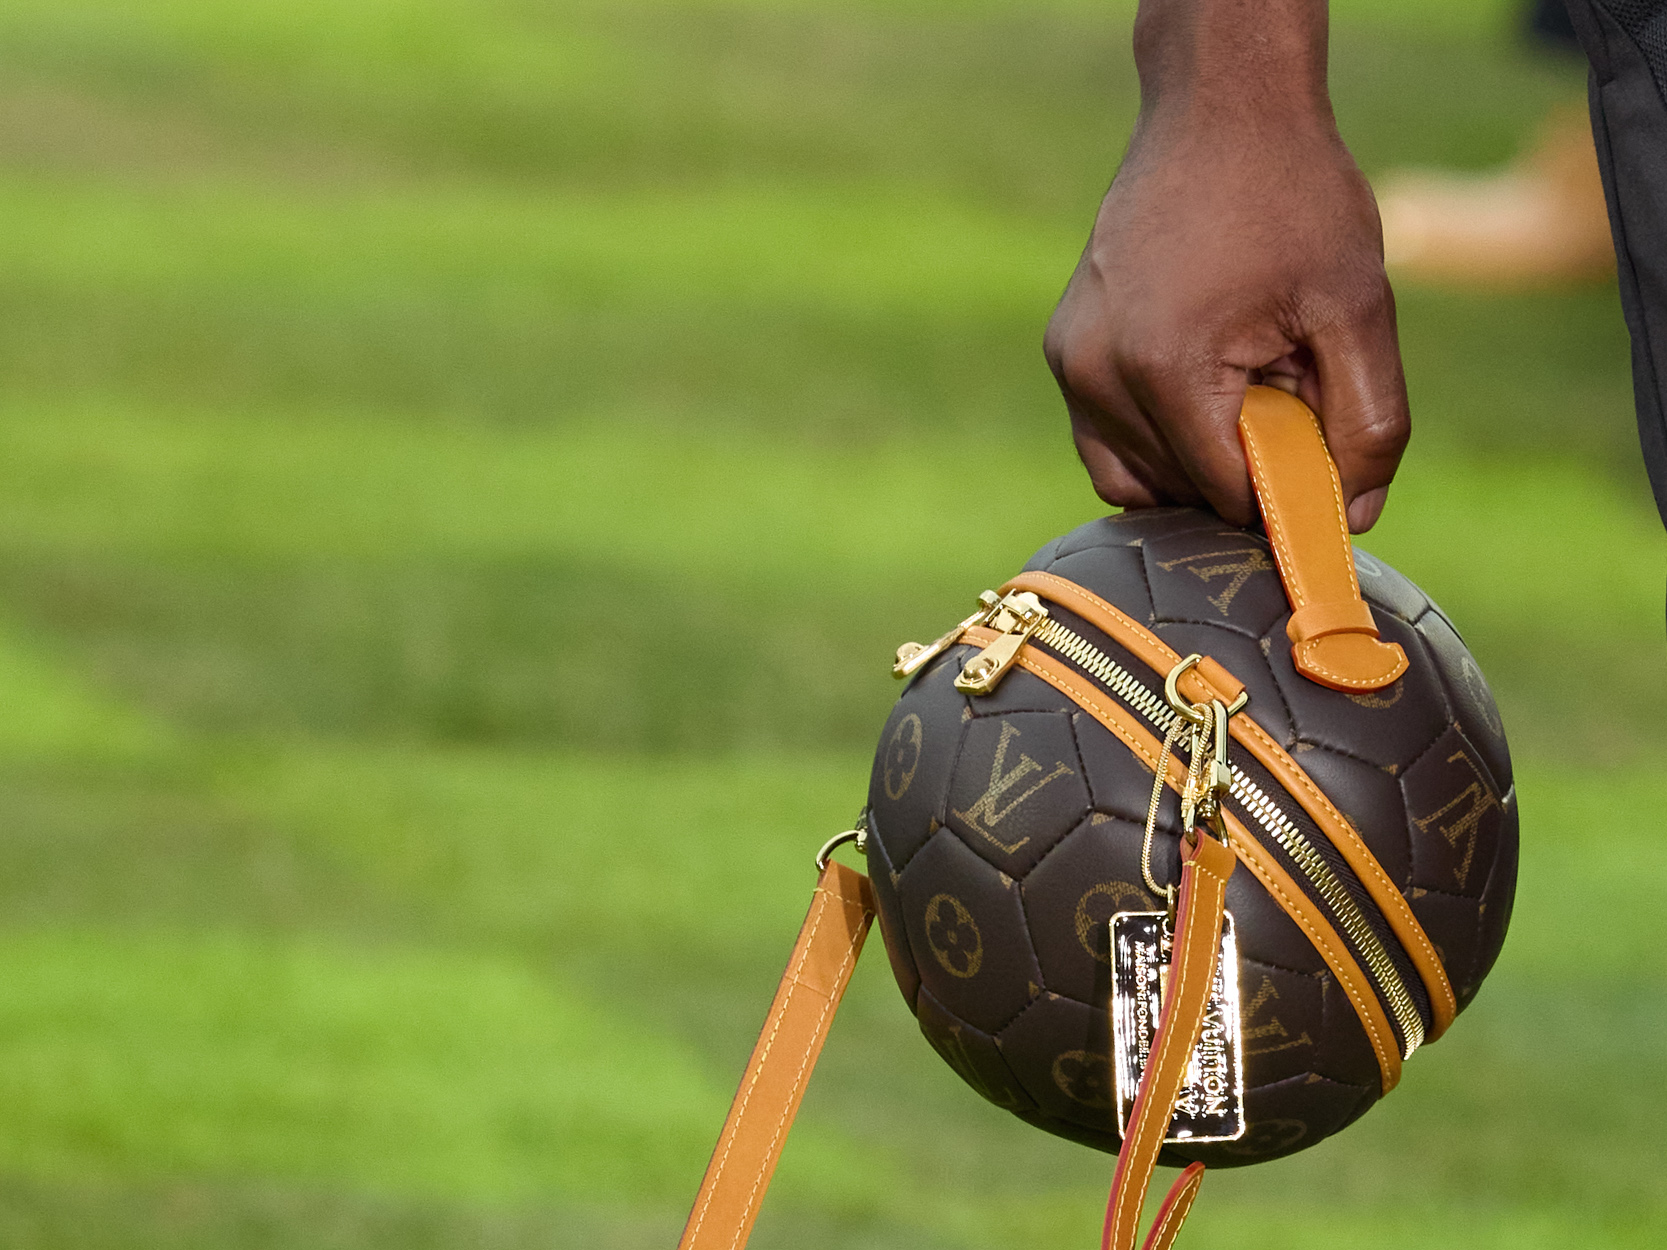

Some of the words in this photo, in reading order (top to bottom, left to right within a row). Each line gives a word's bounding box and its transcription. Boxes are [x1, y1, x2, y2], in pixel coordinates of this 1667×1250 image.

[952, 719, 1075, 855] LV
[1411, 749, 1502, 890] LV
[1134, 941, 1150, 997] MAISON
[1201, 1010, 1229, 1118] VUITTON
